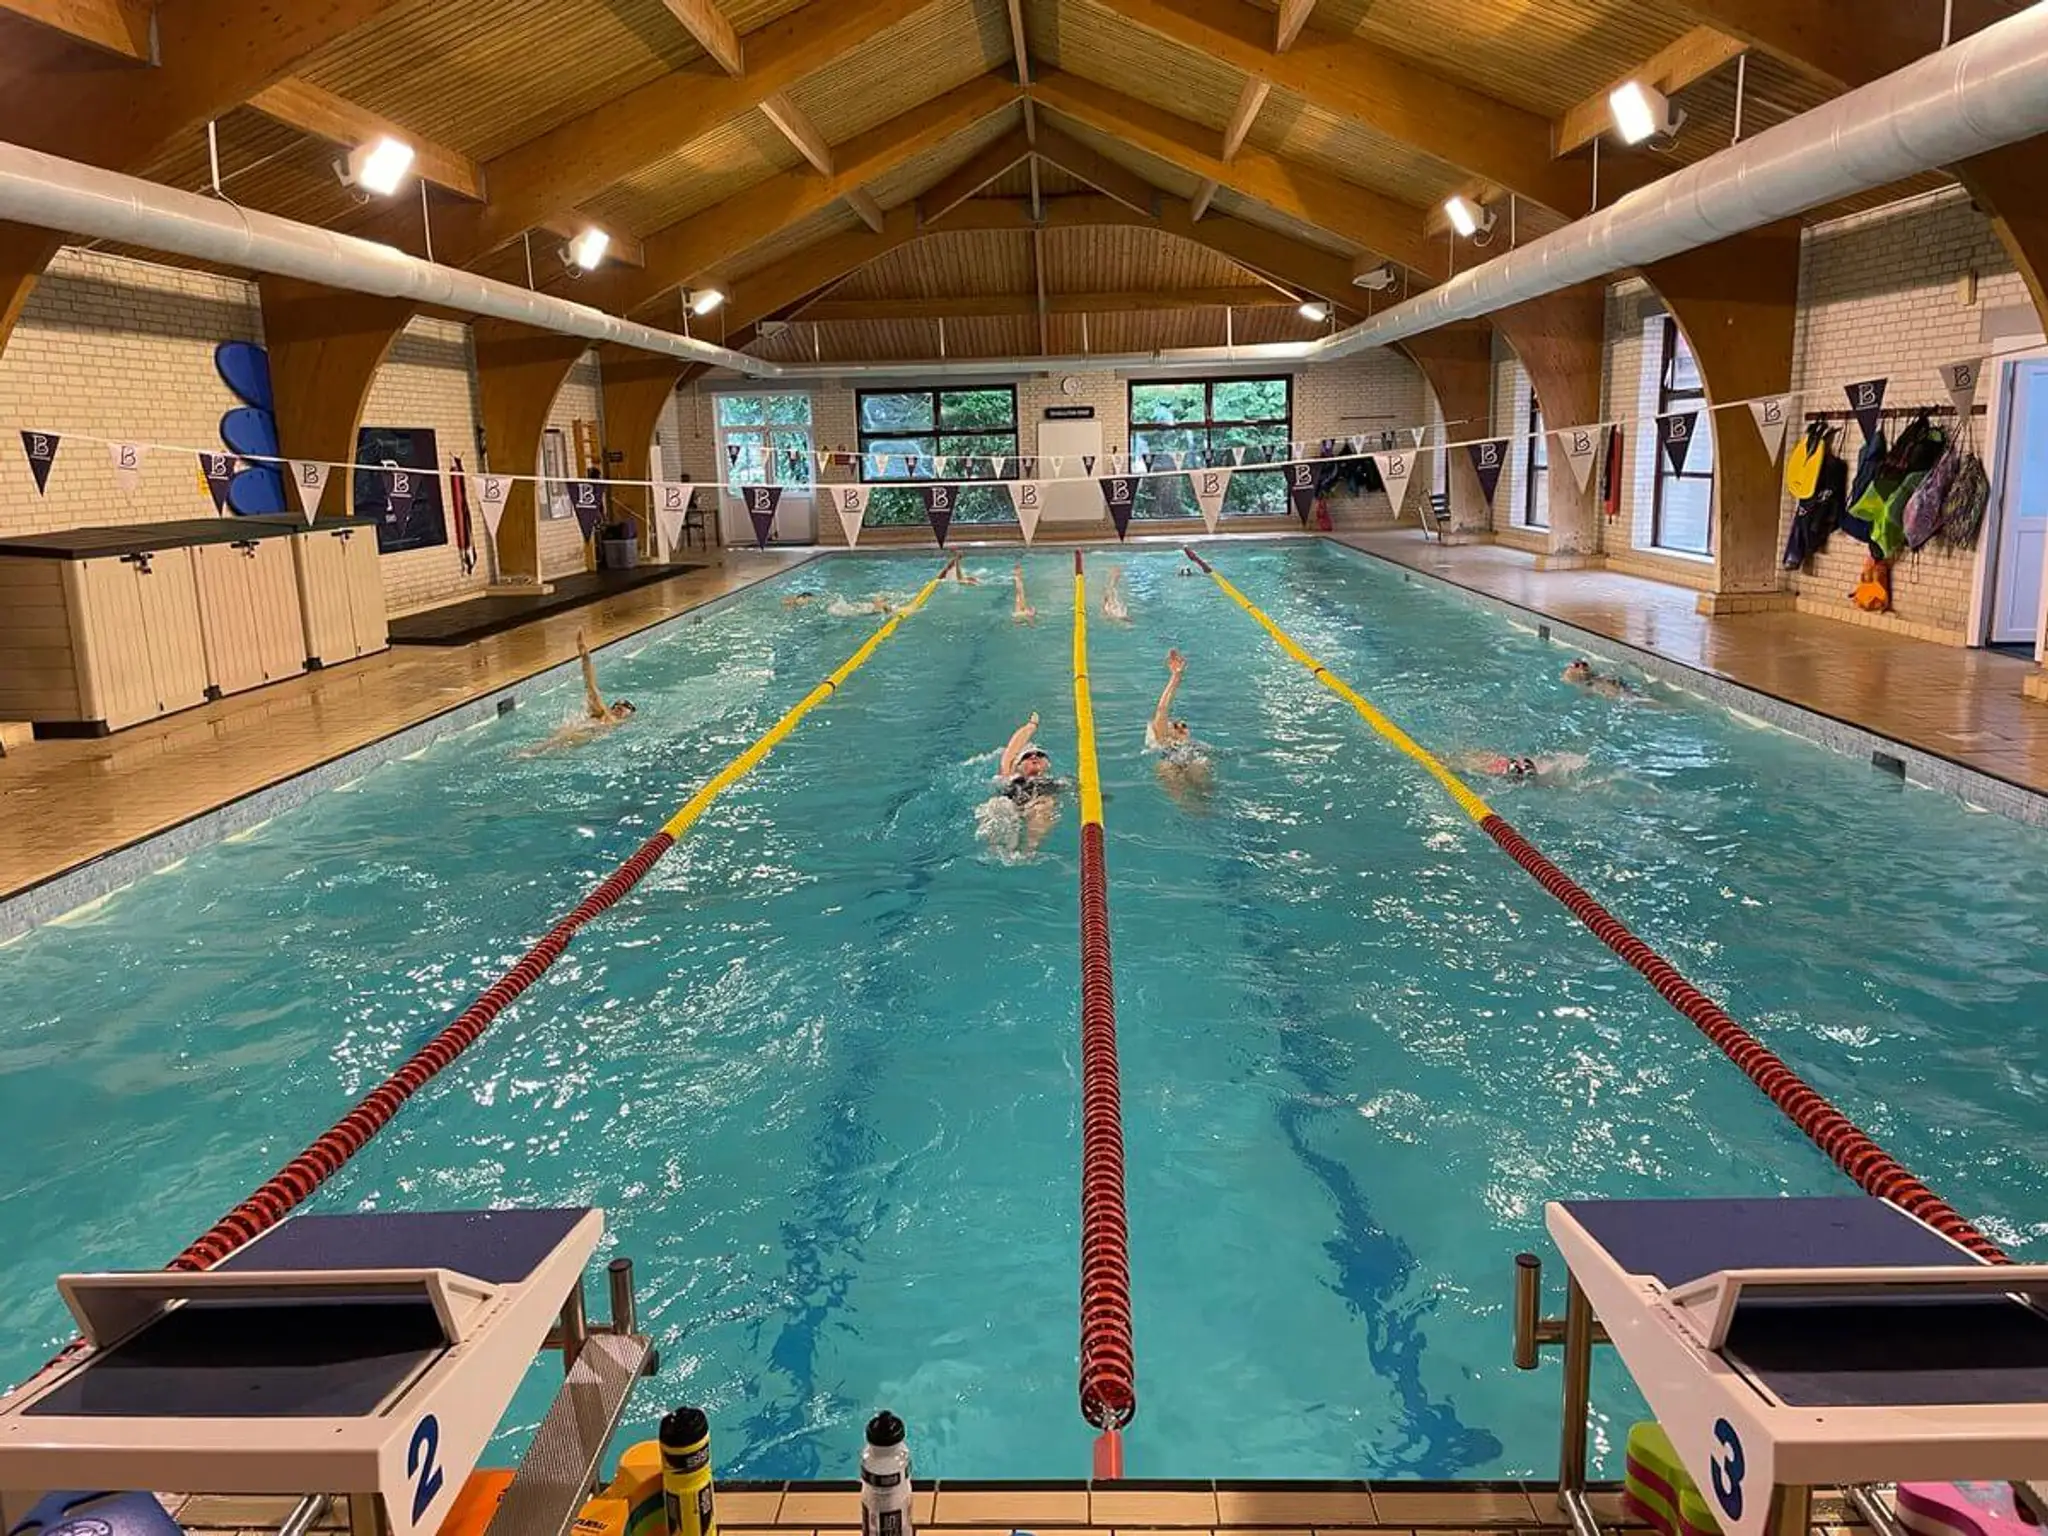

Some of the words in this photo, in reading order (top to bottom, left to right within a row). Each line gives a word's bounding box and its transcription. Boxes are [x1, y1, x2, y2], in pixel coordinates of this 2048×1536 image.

[1954, 366, 1972, 387] B
[1858, 384, 1876, 405] B
[1764, 400, 1782, 422] B
[1670, 417, 1687, 438] B
[33, 435, 49, 454] B
[1574, 431, 1590, 451] B
[121, 446, 136, 466] B
[211, 454, 227, 475] B
[1480, 444, 1498, 465] B
[303, 464, 319, 484] B
[1295, 464, 1312, 486] B
[1388, 455, 1404, 476] B
[393, 472, 410, 493] B
[485, 478, 501, 499] B
[1112, 480, 1130, 501] B
[1203, 472, 1220, 493] B
[578, 483, 595, 504] B
[665, 487, 681, 508] B
[754, 488, 771, 509] B
[844, 488, 860, 508] B
[932, 487, 949, 508] B
[1021, 484, 1037, 505] B
[408, 1413, 443, 1528] 2
[1710, 1418, 1745, 1521] 3
